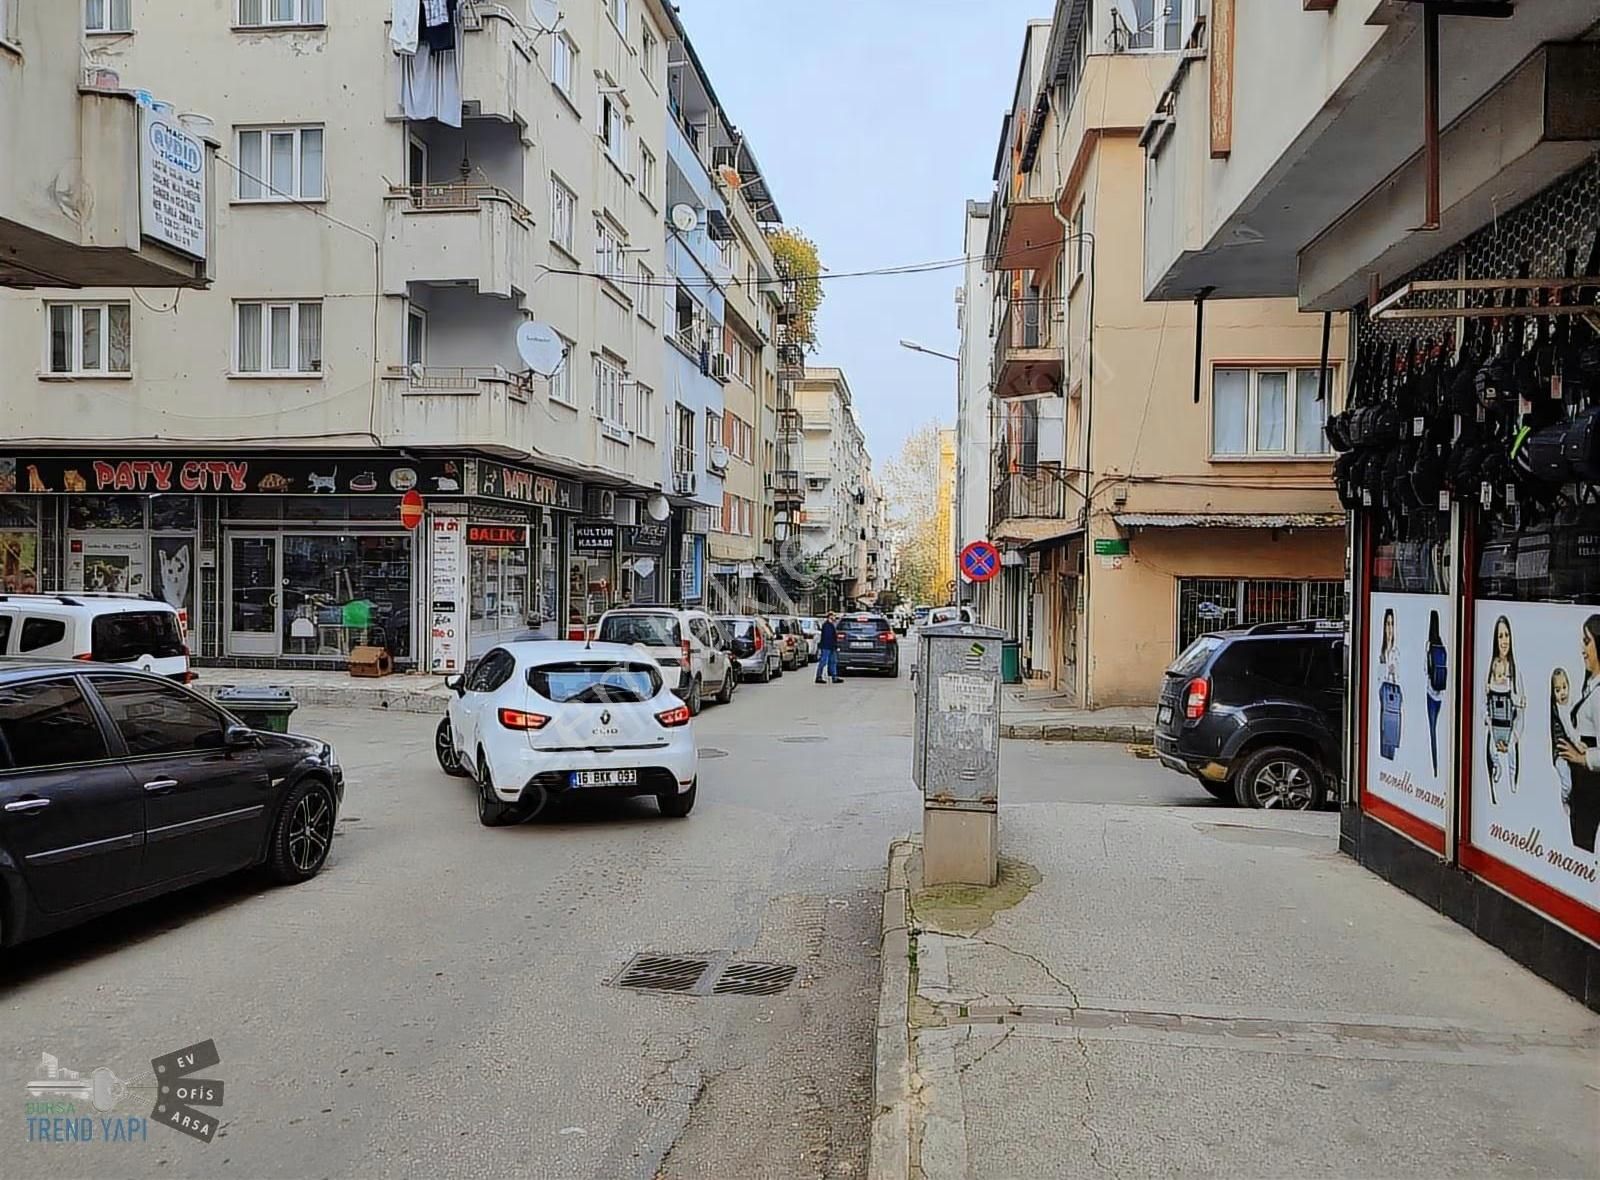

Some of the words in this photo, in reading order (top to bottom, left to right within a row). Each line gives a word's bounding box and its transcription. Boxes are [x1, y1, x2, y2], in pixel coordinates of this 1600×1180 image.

[93, 461, 173, 490] PATY
[503, 467, 533, 501] PATY
[592, 728, 618, 736] CLIO
[578, 772, 589, 784] 16
[594, 771, 611, 783] BKK
[617, 770, 636, 782] 093
[1379, 770, 1413, 793] monello
[1415, 786, 1447, 809] mami
[1489, 823, 1544, 857] monello
[1547, 849, 1598, 883] mami
